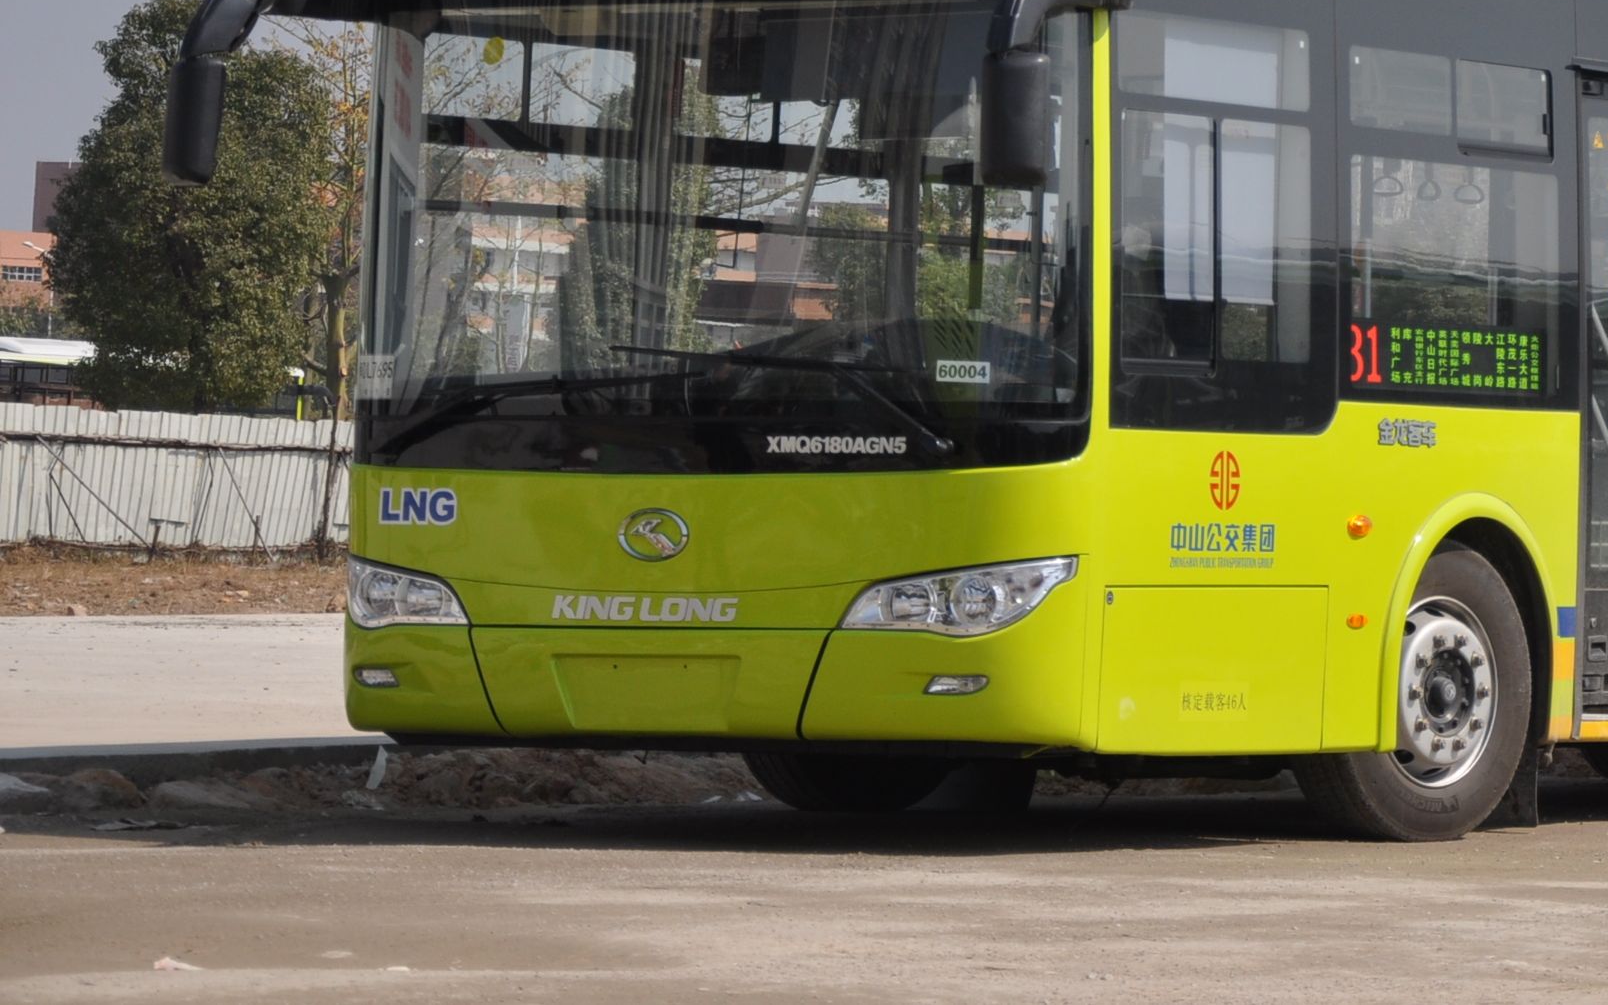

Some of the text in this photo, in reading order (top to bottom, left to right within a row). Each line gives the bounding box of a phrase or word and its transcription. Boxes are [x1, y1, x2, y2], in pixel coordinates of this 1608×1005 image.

[1390, 327, 1401, 383] 利和广场
[1426, 329, 1436, 385] 中山日报
[938, 364, 988, 380] 60004
[766, 435, 907, 455] XMQ6180AGN5
[1378, 418, 1437, 448] 金龙客车
[380, 489, 457, 524] LNG
[1170, 523, 1275, 552] 中山公交集团
[551, 596, 739, 623] KING LONG
